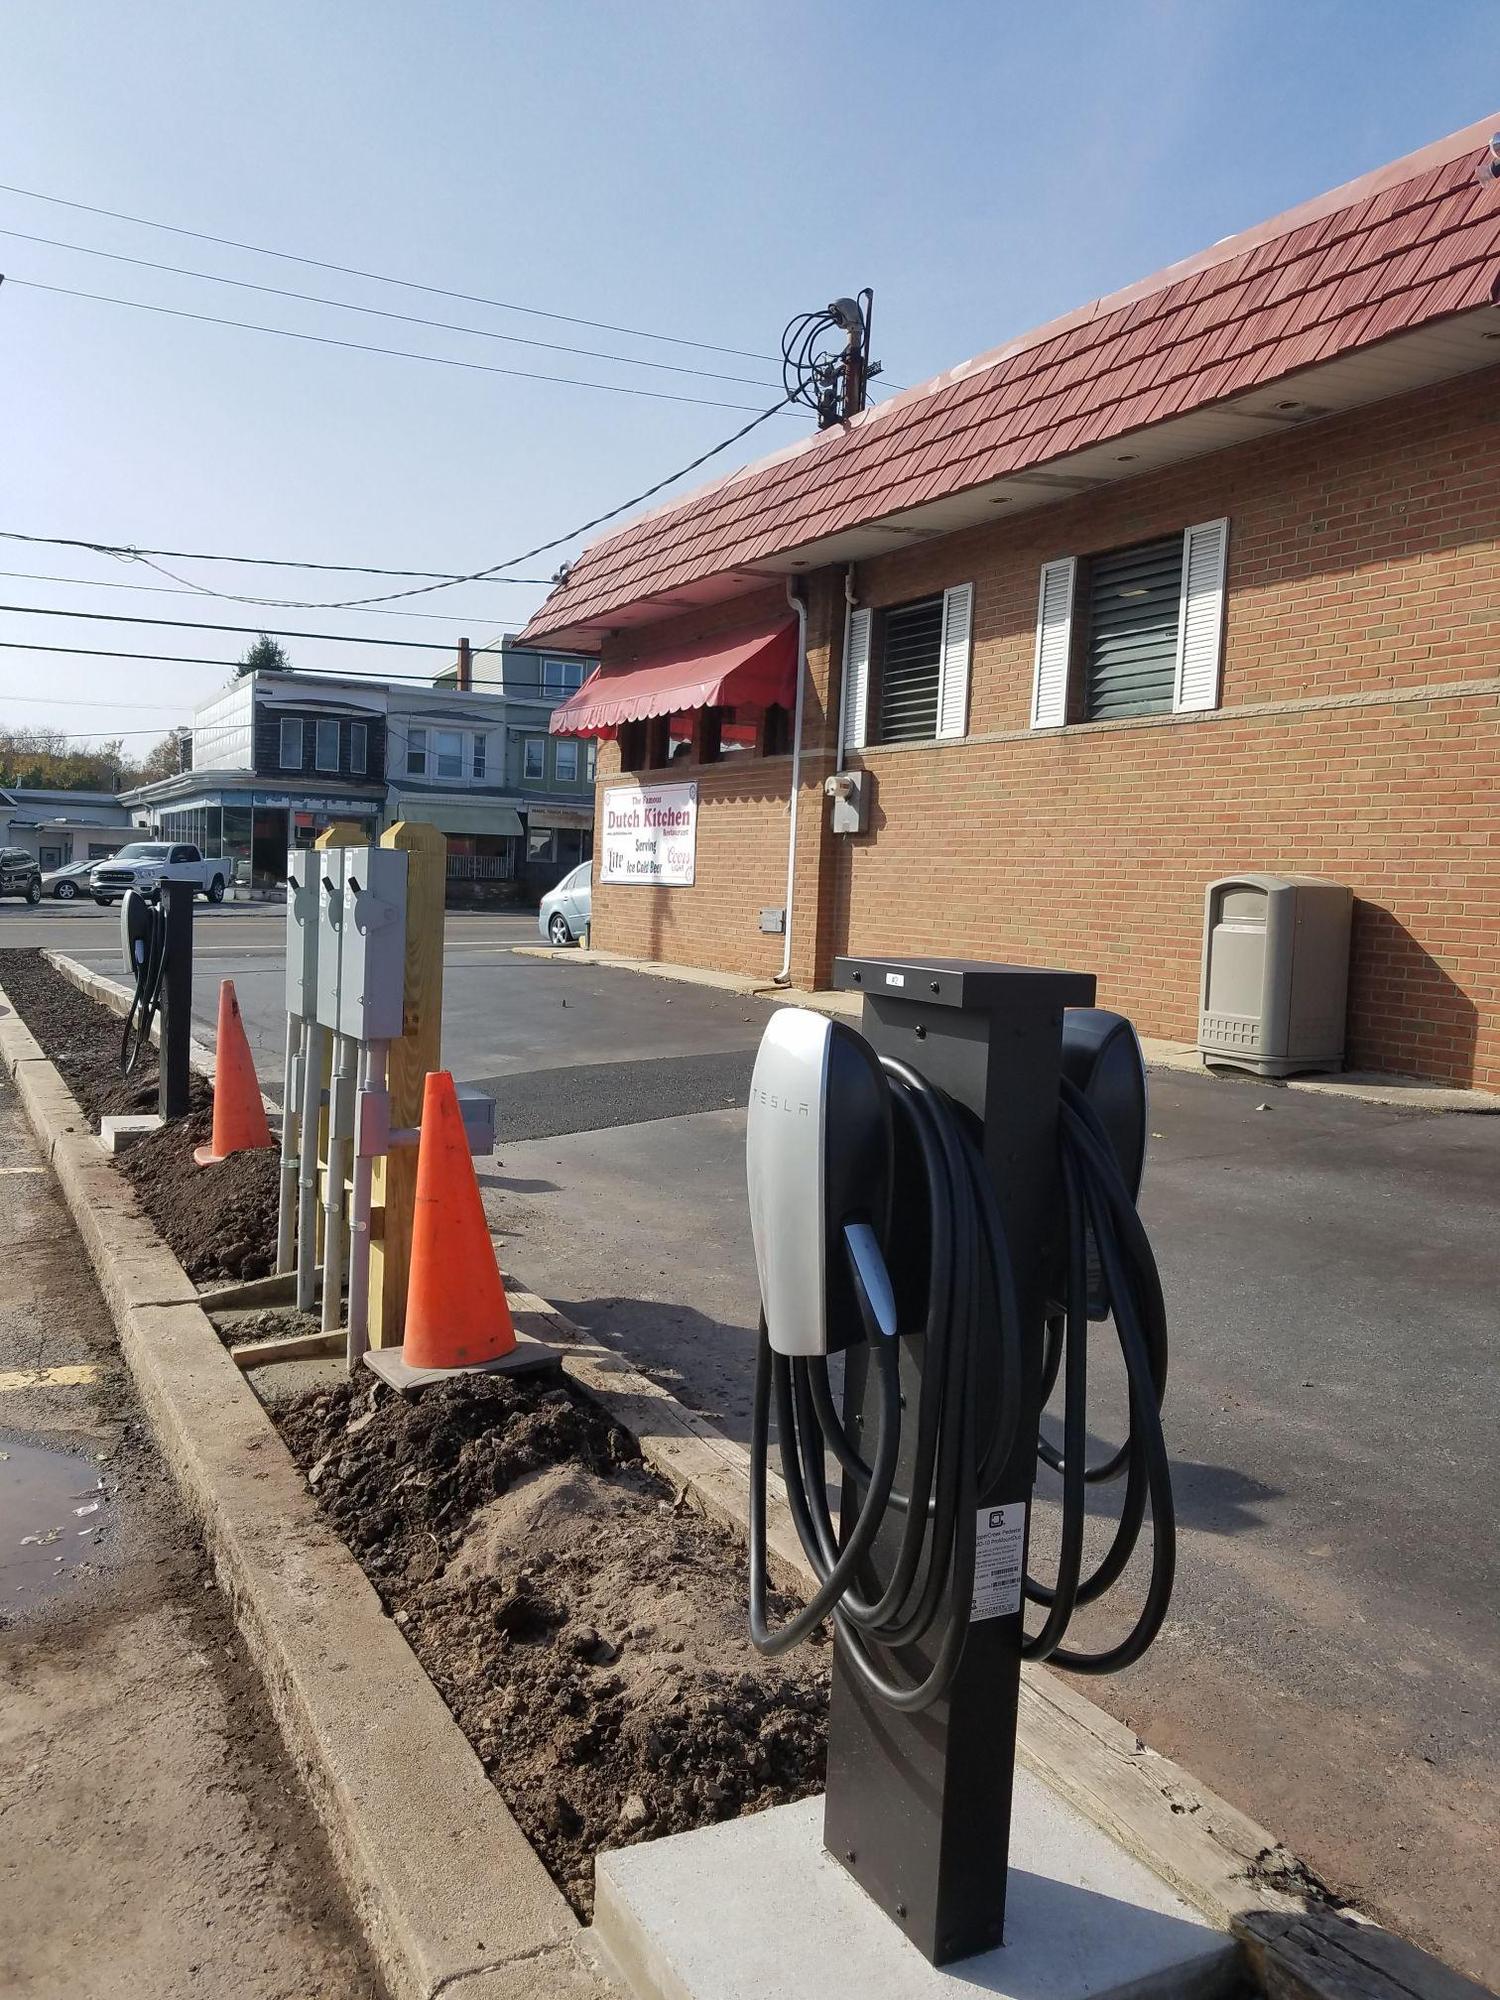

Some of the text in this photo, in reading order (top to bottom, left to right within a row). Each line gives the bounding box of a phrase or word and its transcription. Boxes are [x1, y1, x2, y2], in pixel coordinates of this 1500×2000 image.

[642, 795, 662, 804] Famous
[608, 806, 690, 829] Dutch Kitchen
[635, 839, 657, 855] Serving
[667, 846, 690, 864] Coors
[609, 850, 624, 873] Lite
[626, 860, 663, 875] Ice Cold Beer
[753, 1088, 808, 1115] TESLA
